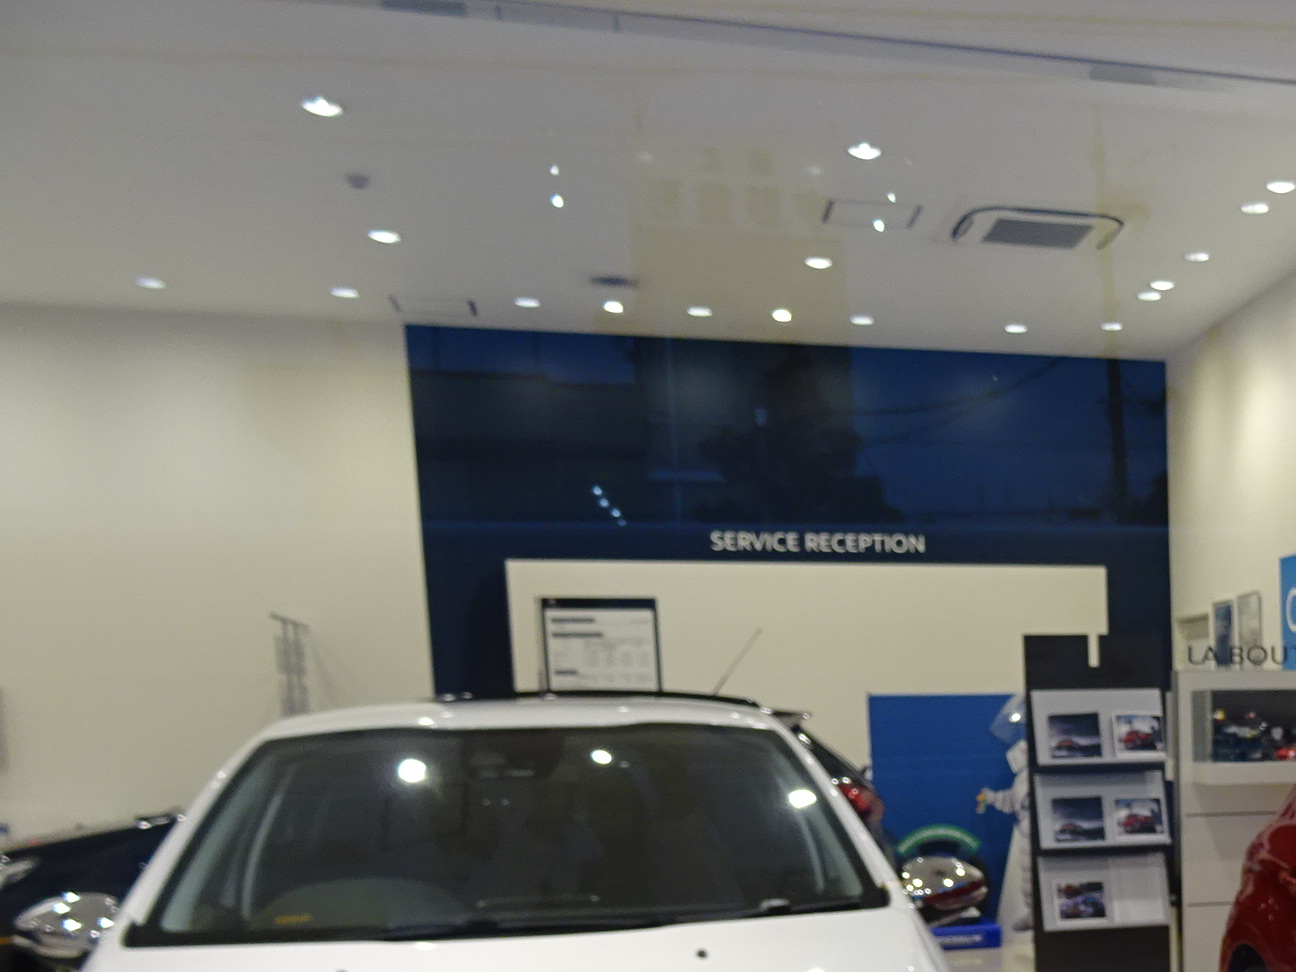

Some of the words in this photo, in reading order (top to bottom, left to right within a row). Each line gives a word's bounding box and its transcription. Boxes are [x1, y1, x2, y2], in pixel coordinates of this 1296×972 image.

[709, 530, 800, 552] SERVICE
[804, 532, 926, 554] RECEPTION
[1187, 645, 1218, 666] LA
